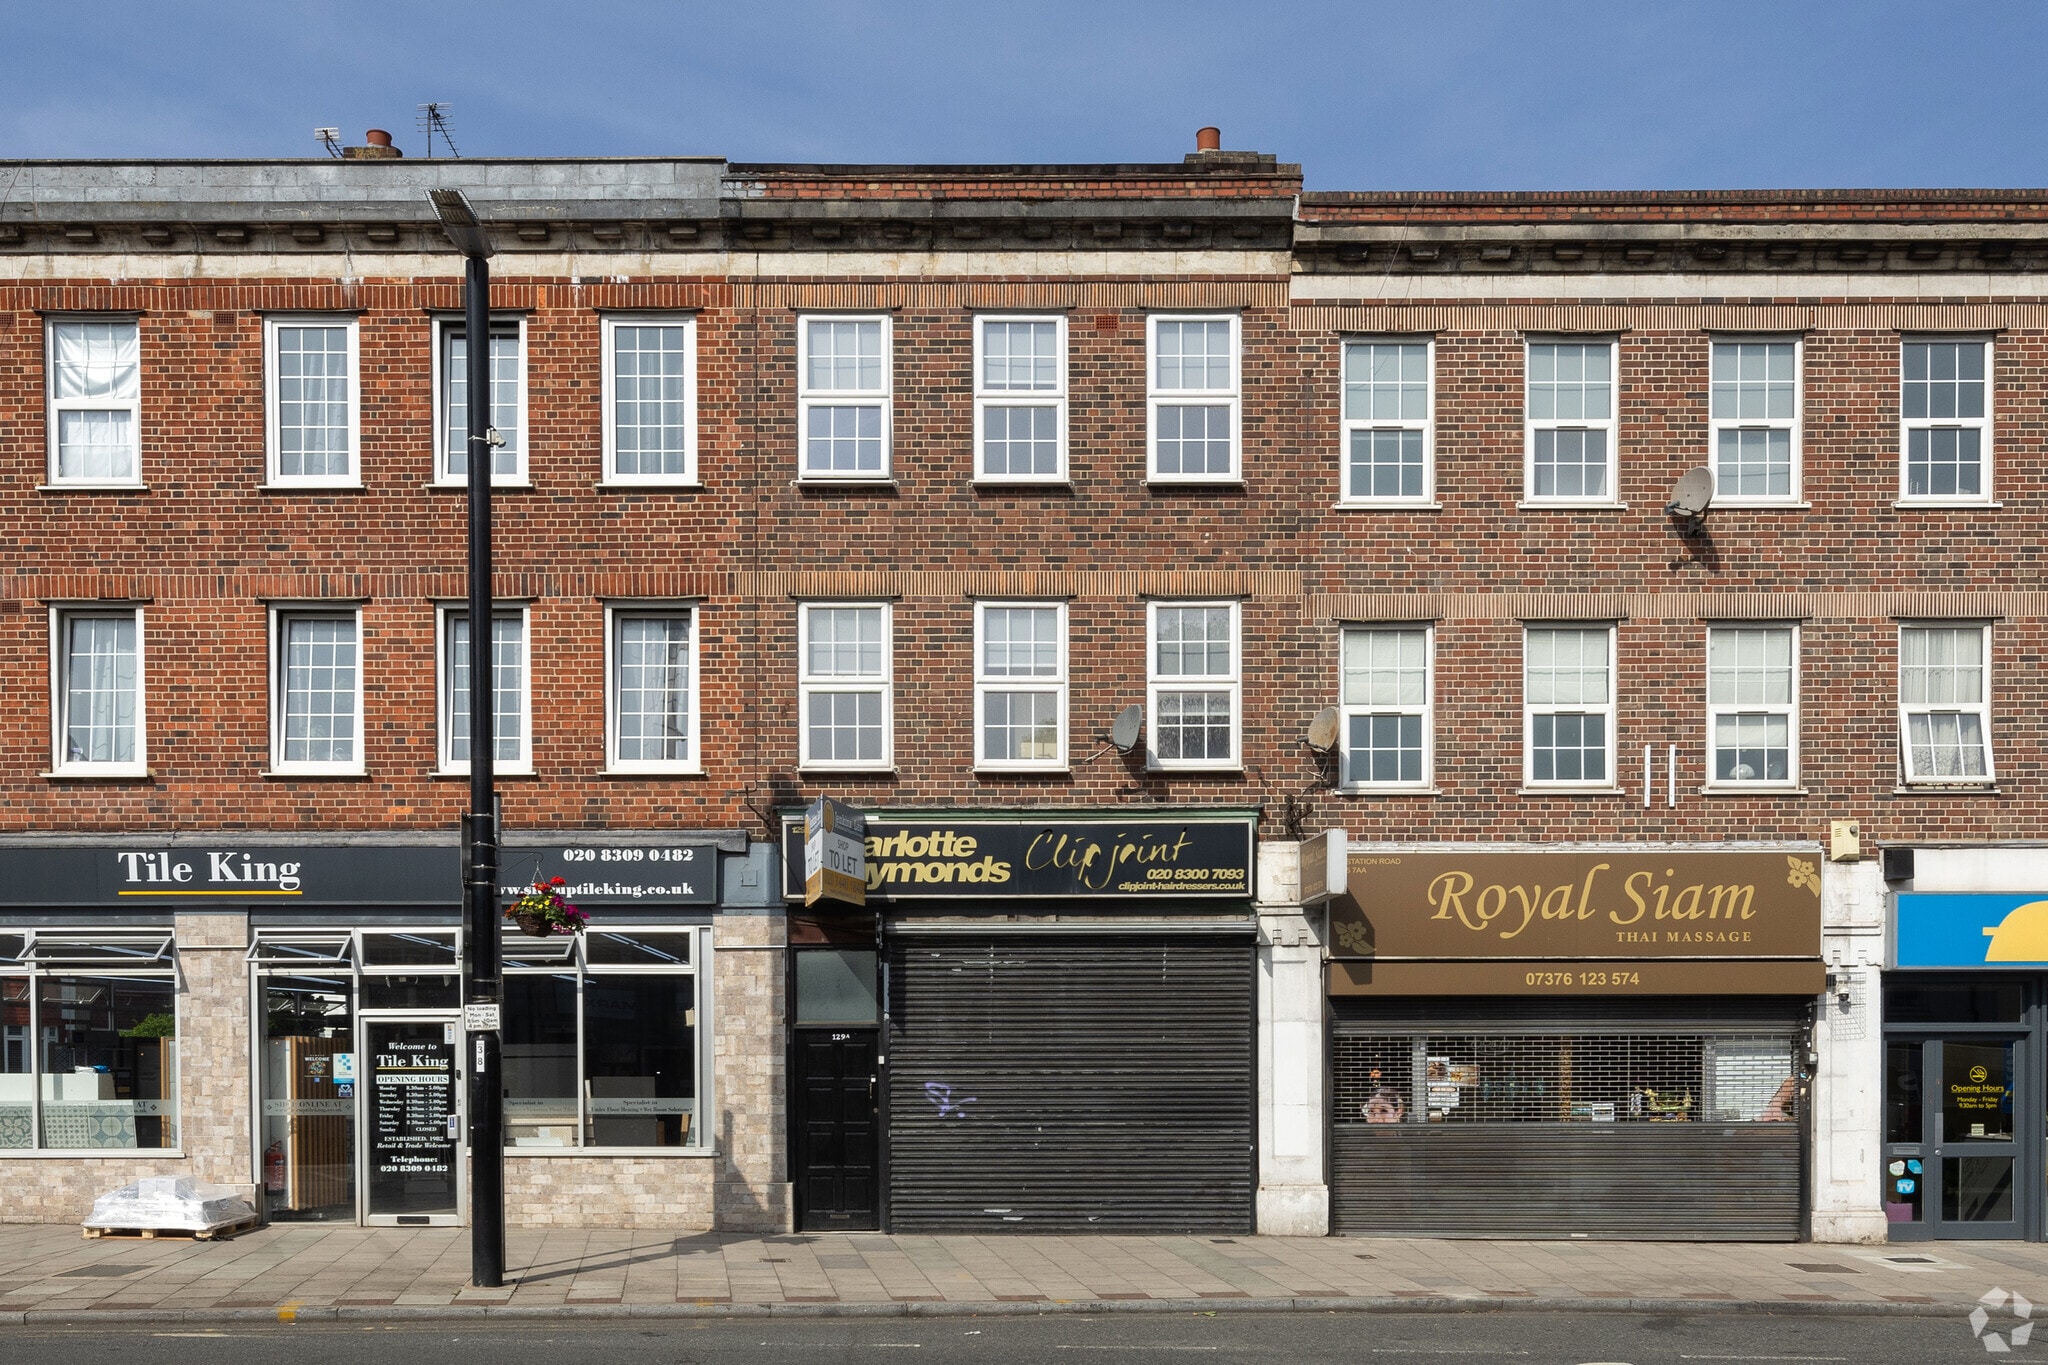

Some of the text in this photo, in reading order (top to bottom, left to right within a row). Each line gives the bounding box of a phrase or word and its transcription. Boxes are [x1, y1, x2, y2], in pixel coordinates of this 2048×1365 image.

[837, 839, 850, 851] SHOP
[864, 830, 978, 858] arlotte
[563, 849, 694, 862] 020 8309 0482
[1025, 827, 1194, 890] Clip joint
[829, 849, 858, 875] TO LET
[118, 852, 301, 891] Tile King
[864, 855, 1012, 891] ymonds
[1146, 868, 1245, 880] 020 8300 7093
[1118, 881, 1245, 893] clipjoint-hairdressers.co.uk
[1427, 863, 1757, 939] Royal Siam
[1616, 931, 1753, 943] THAI MASSAGE
[1525, 972, 1640, 986] 07376 123 574
[832, 1033, 850, 1041] 129A
[388, 1042, 438, 1051] Welcome to
[376, 1054, 449, 1071] Tile King
[1951, 1084, 2005, 1093] Opening Hours
[390, 1156, 438, 1164] Telephone:
[1897, 1183, 1913, 1192] TV
